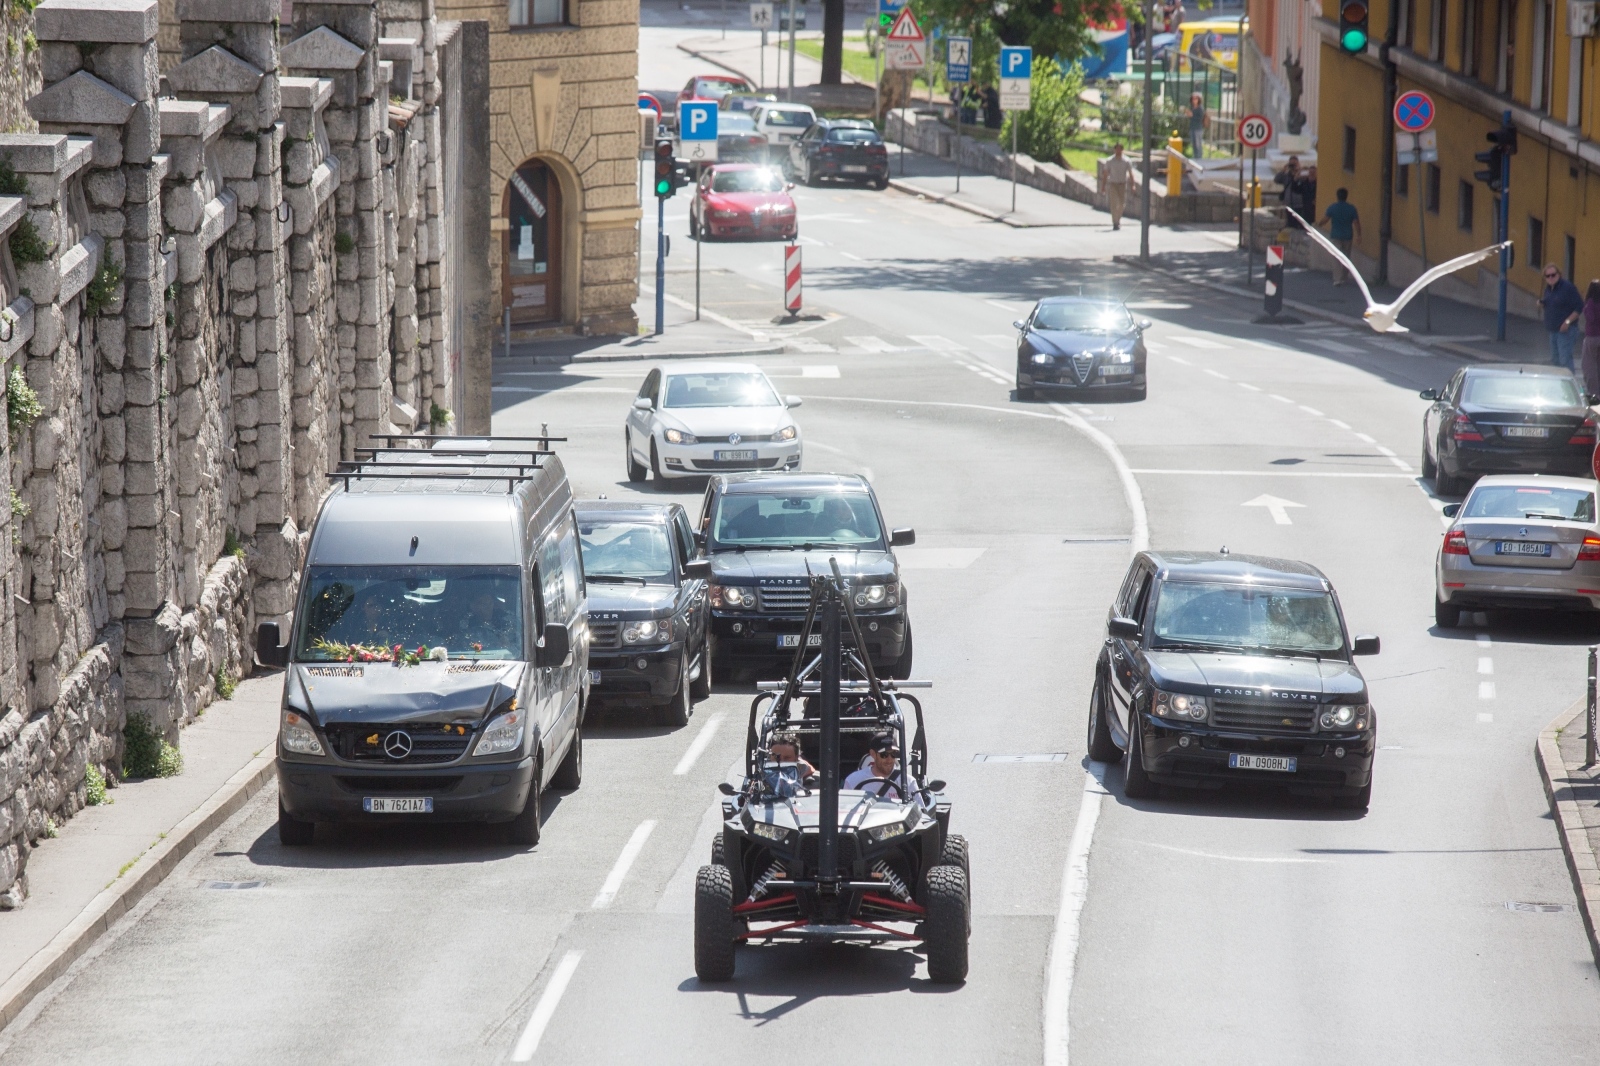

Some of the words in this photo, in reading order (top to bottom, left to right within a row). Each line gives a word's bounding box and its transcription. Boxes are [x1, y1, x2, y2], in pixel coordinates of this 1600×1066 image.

[1008, 52, 1024, 73] P
[690, 108, 708, 134] P
[1246, 123, 1265, 139] 30
[785, 635, 796, 646] GK
[1214, 688, 1262, 697] RANGE
[1272, 692, 1317, 701] ROVER
[1239, 755, 1251, 768] BN
[1255, 757, 1288, 770] 0908HJ
[373, 799, 385, 811] BN
[390, 799, 424, 811] 7621AZ
